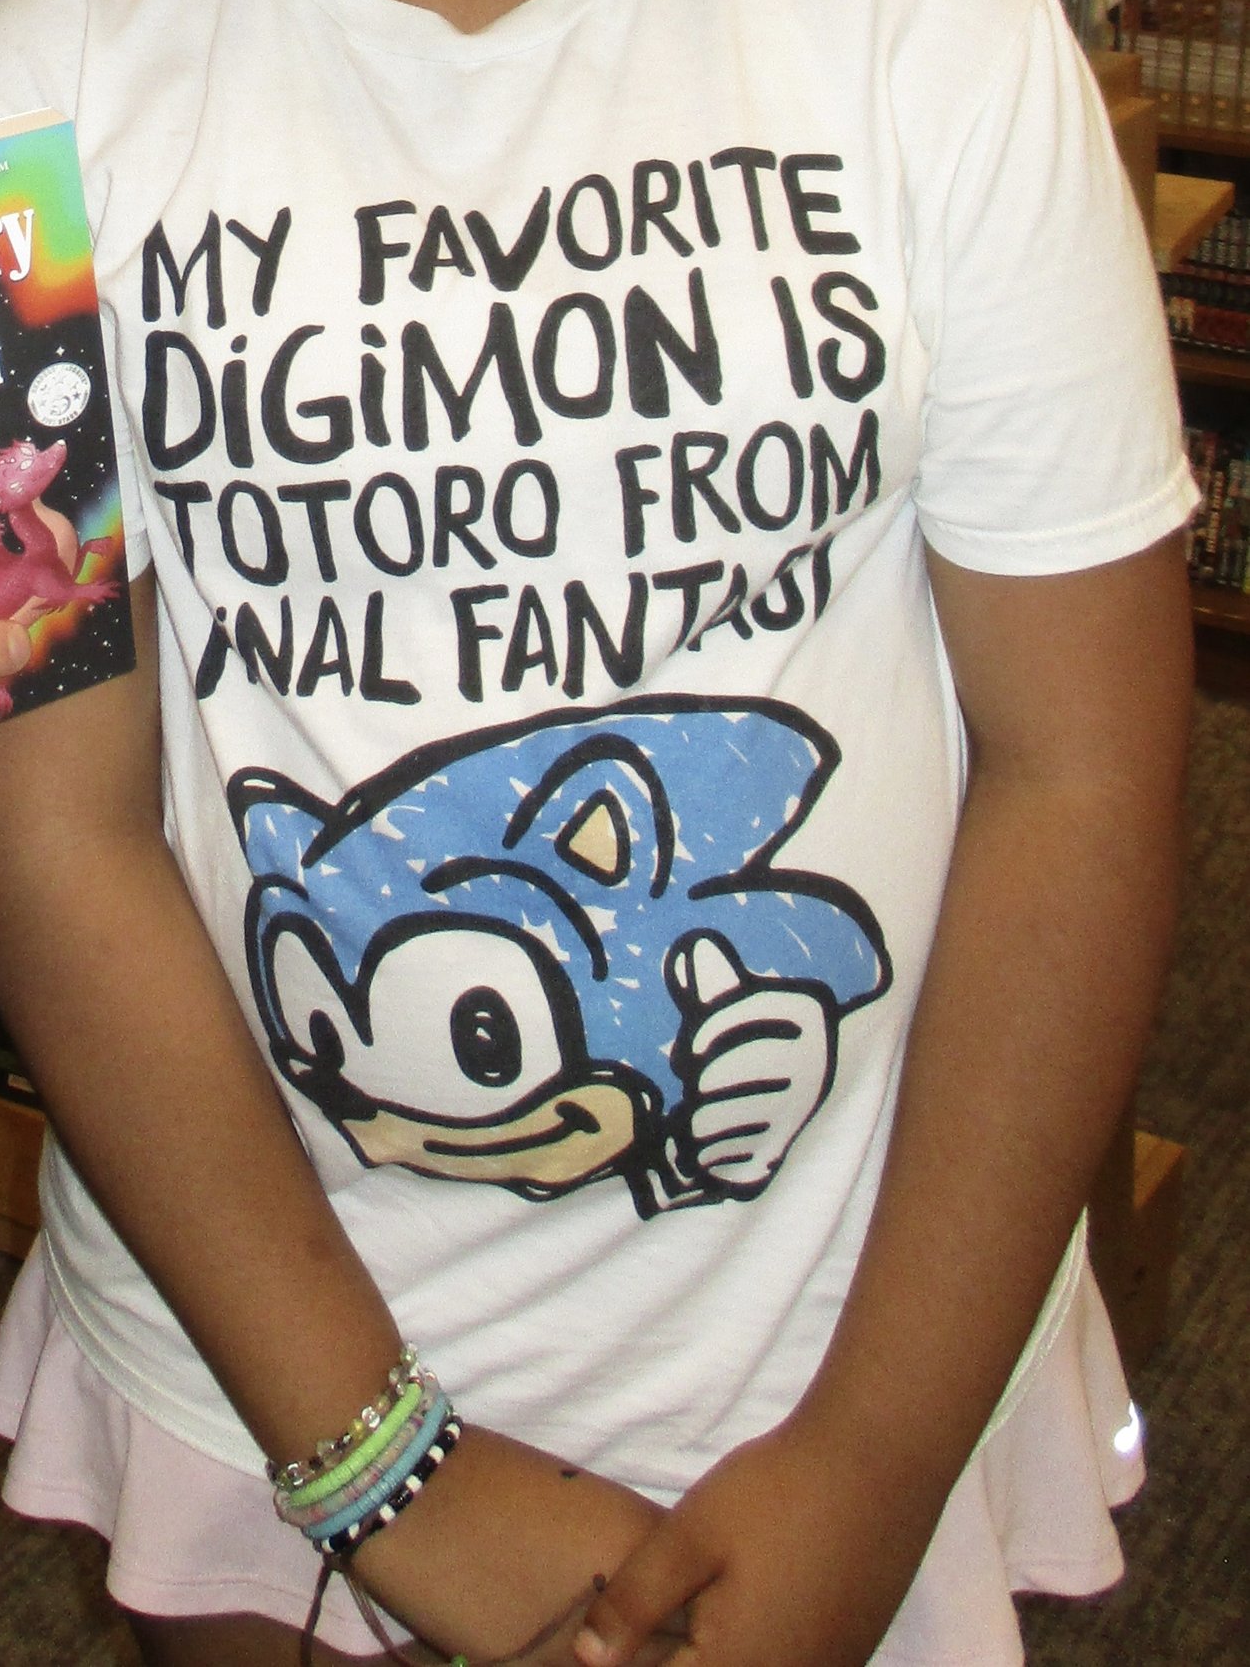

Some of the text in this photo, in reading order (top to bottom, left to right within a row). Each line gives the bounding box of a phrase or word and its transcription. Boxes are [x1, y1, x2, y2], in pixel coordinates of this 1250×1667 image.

[141, 145, 861, 330] MY FAVORITE
[771, 271, 887, 403] IS
[152, 409, 881, 587] TOTORO FROM
